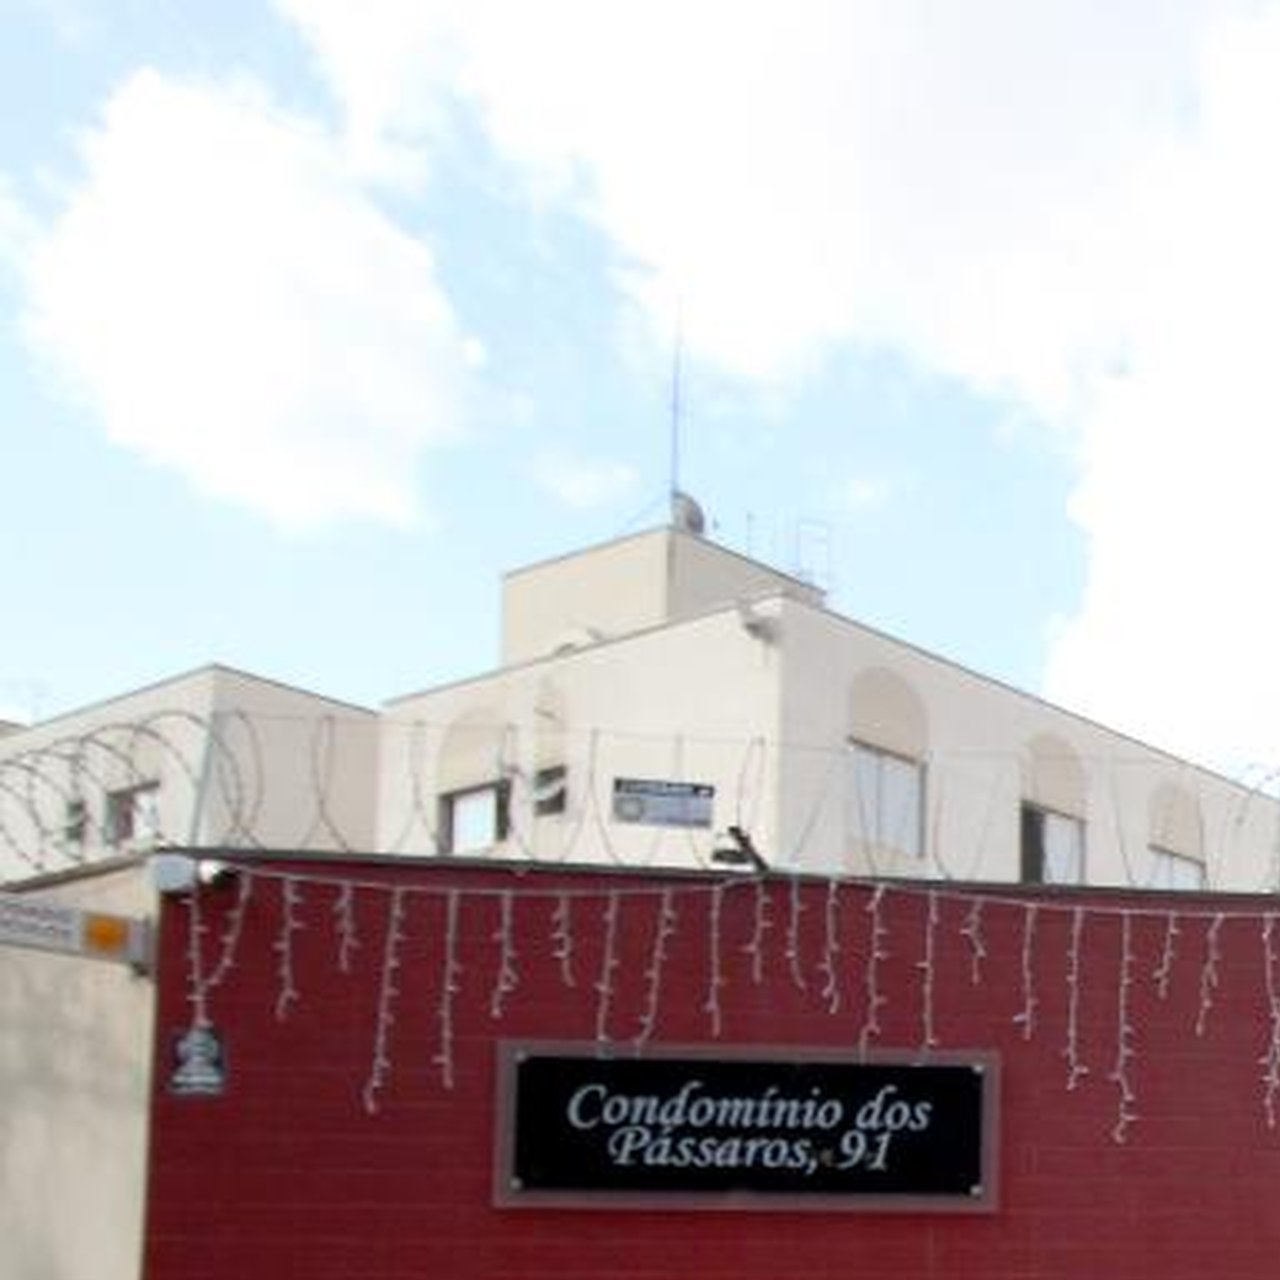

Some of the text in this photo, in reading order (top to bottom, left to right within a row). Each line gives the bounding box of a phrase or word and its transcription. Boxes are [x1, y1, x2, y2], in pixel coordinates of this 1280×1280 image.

[567, 1081, 933, 1131] Condomínio dos
[608, 1125, 892, 1174] Pássaros, 91
